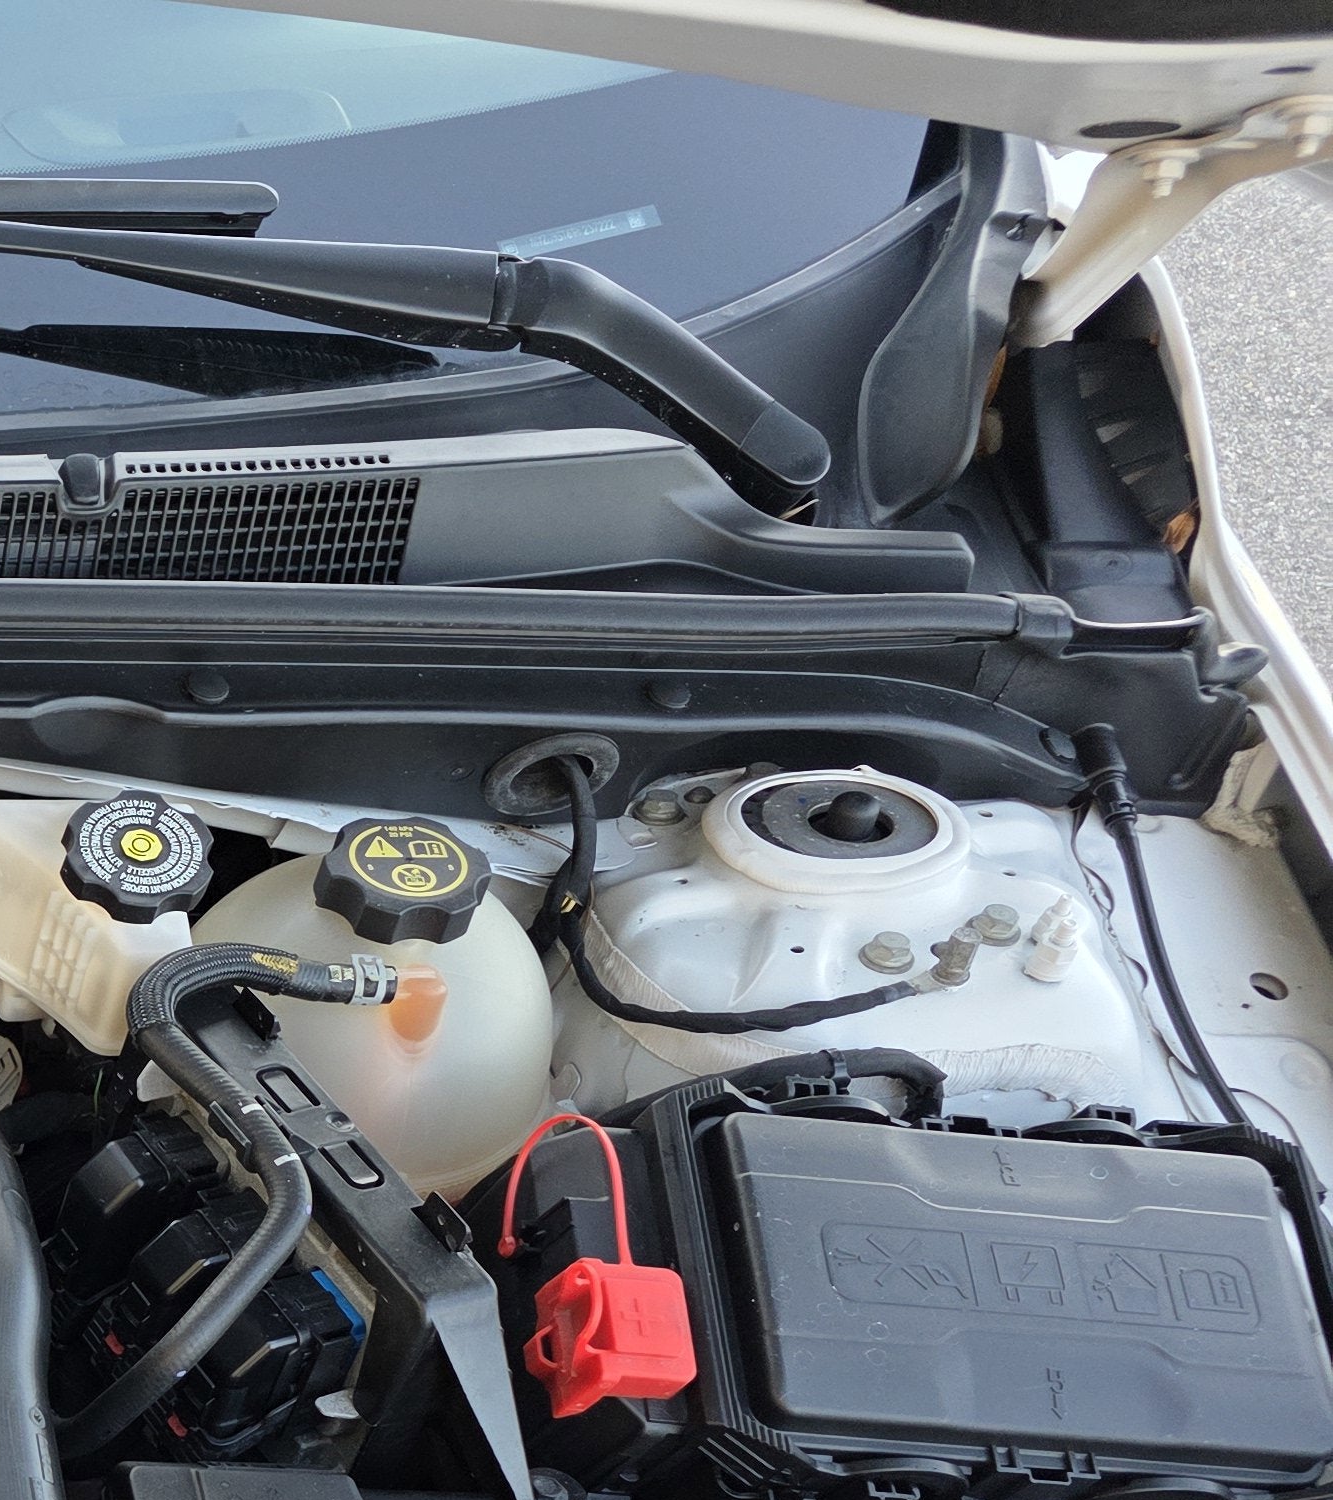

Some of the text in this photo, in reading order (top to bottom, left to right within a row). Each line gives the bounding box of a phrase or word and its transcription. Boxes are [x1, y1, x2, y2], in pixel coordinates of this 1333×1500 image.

[109, 799, 132, 809] FLUID
[140, 799, 156, 809] DOT
[89, 804, 110, 819] FROM
[105, 808, 135, 820] BEFORE
[137, 808, 154, 817] CAP
[80, 822, 92, 845] SEALED
[103, 847, 123, 866] FILLER
[98, 858, 117, 874] ONLY
[118, 871, 127, 879] 4
[124, 873, 138, 883] DOT
[140, 876, 161, 884] FREIN
